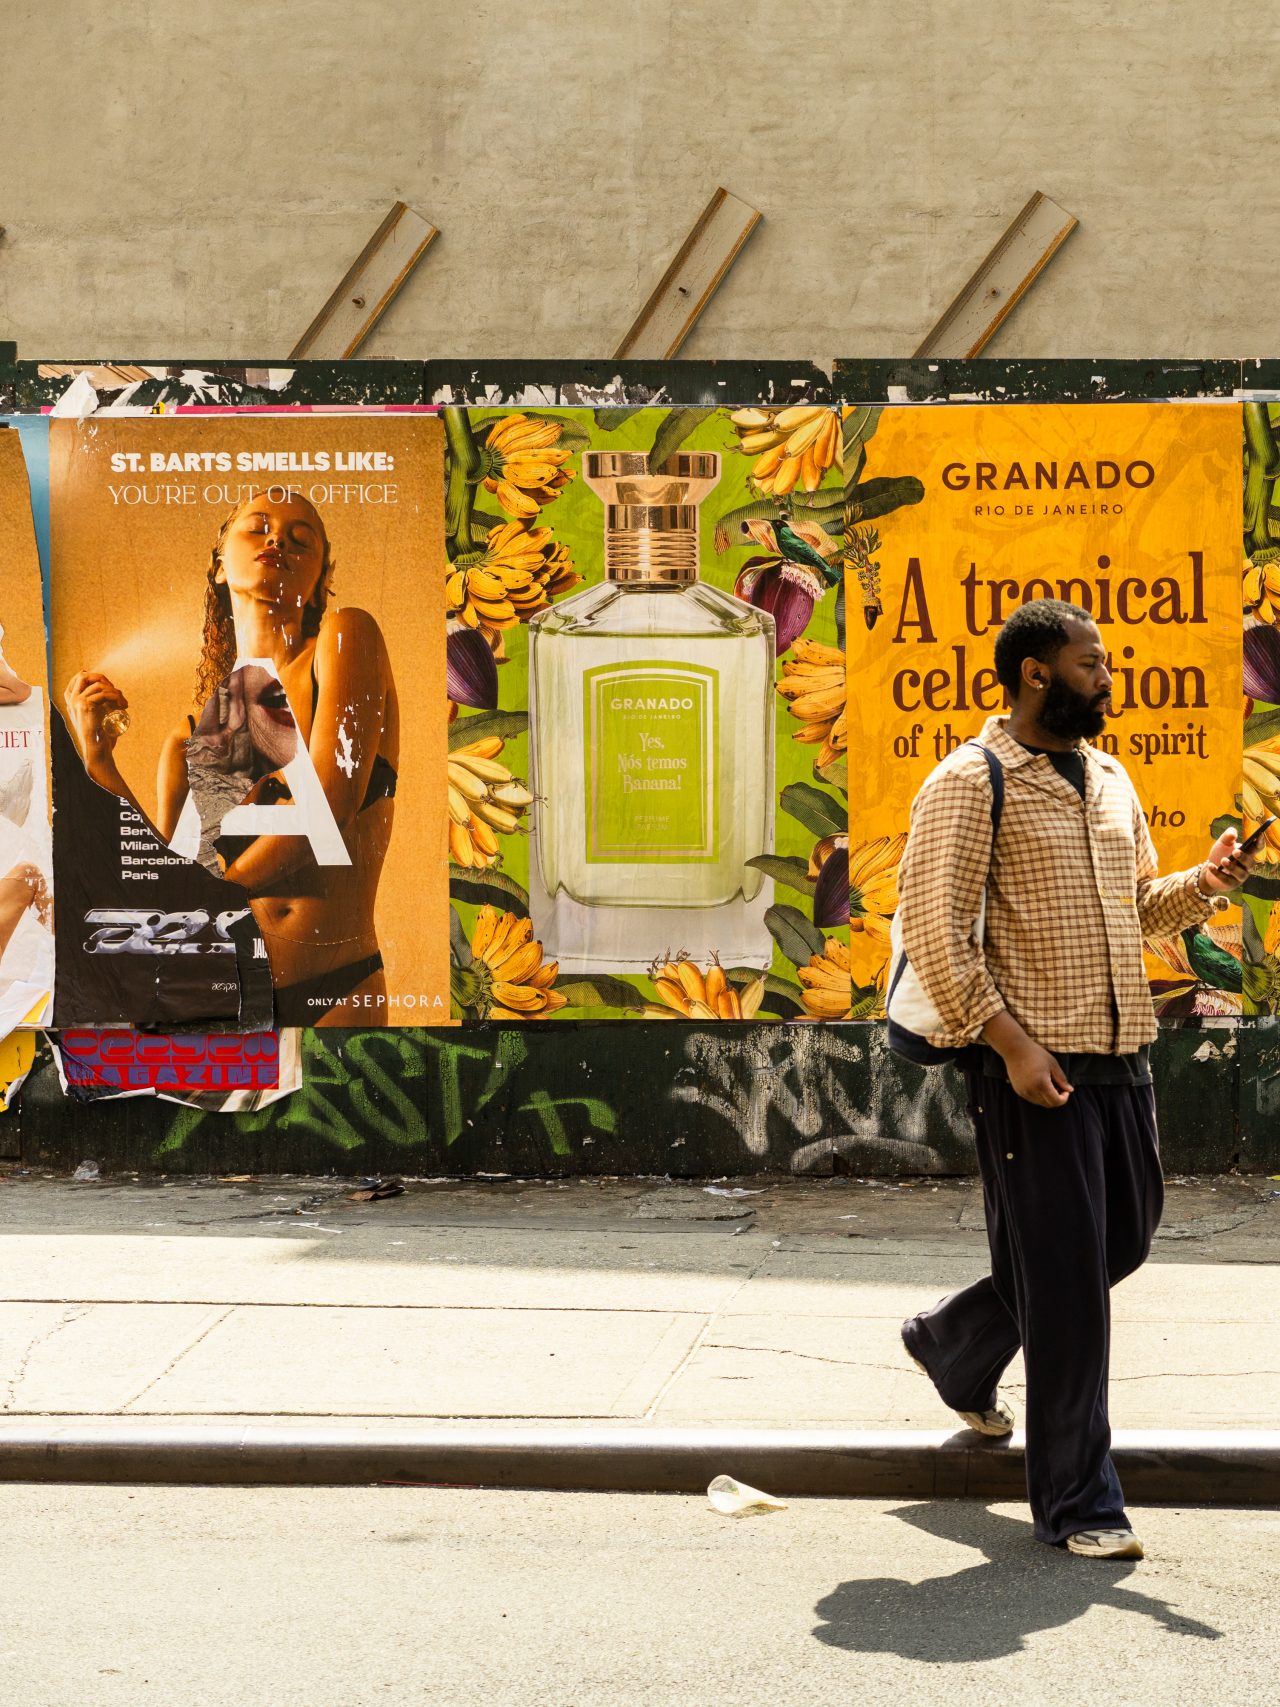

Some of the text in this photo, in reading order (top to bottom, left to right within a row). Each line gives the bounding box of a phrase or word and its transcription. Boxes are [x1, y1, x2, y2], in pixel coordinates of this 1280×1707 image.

[111, 451, 394, 472] ST. BARTS SMELLS LIKE:
[942, 461, 1154, 490] GRANADO
[204, 485, 259, 504] OUT
[267, 485, 300, 503] OF
[309, 484, 398, 504] OFFICE
[975, 504, 1123, 516] RIO DE JANEIRO
[893, 558, 937, 643] A
[893, 645, 1208, 718] celetion
[611, 698, 693, 710] GRANADO
[639, 732, 665, 752] Yes,
[894, 724, 923, 758] of
[933, 724, 977, 762] th
[1130, 723, 1209, 765] spirit
[618, 753, 687, 772] Nós temos
[623, 774, 682, 794] Banana!
[121, 841, 159, 851] Milan
[121, 856, 194, 865] Barcelona
[122, 871, 159, 880] Paris
[307, 994, 444, 1008] ONLY AT SEPHORA
